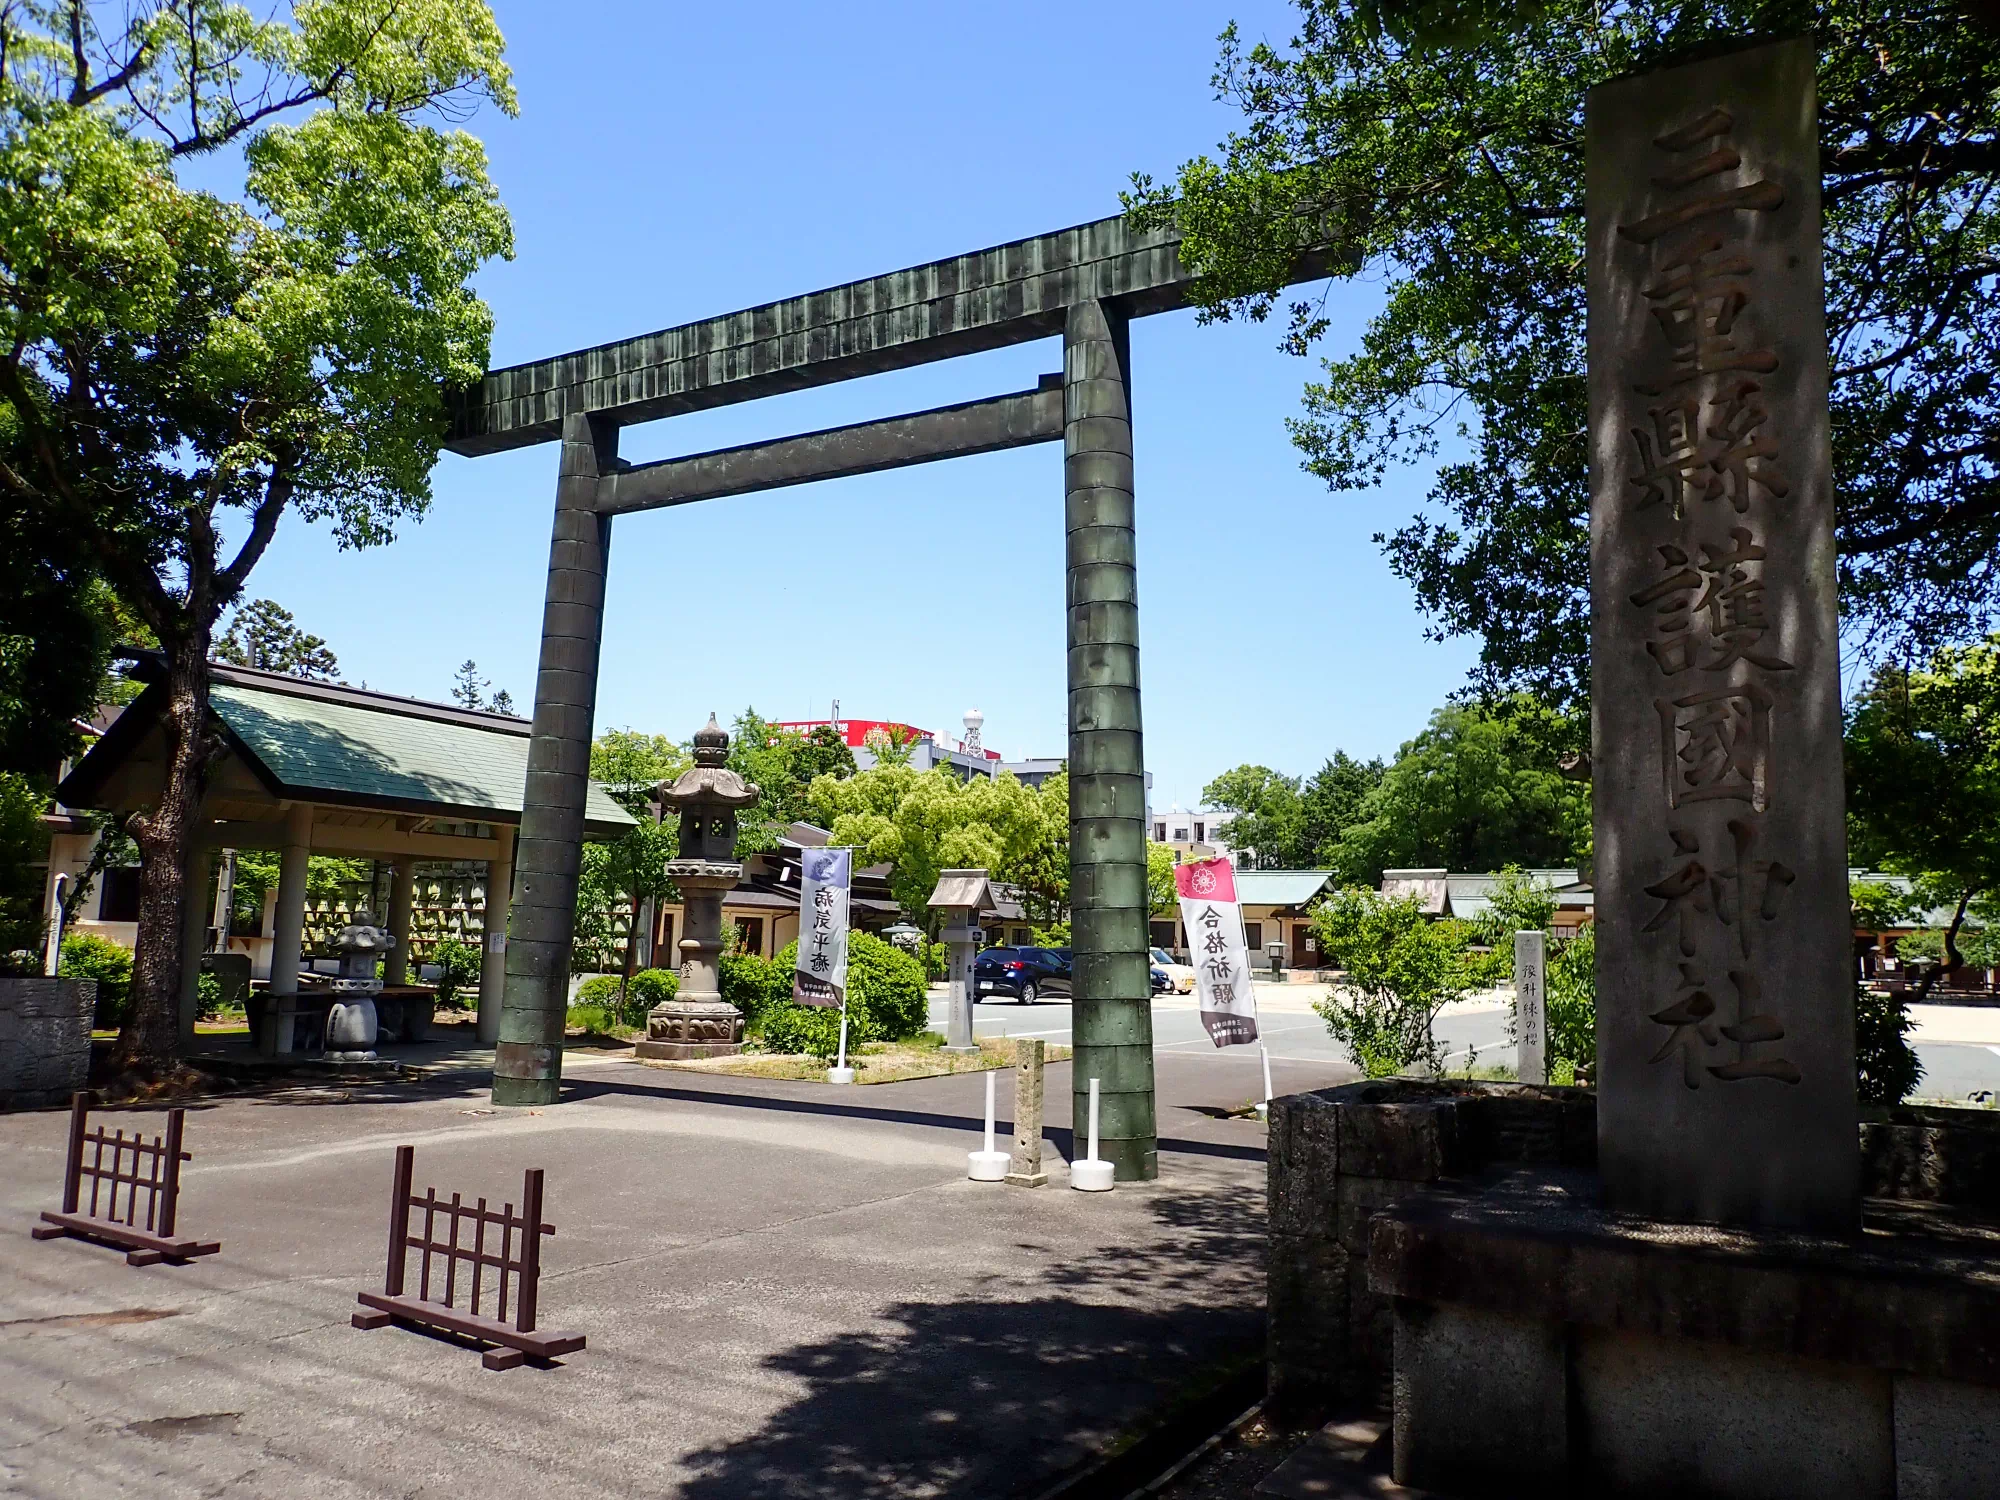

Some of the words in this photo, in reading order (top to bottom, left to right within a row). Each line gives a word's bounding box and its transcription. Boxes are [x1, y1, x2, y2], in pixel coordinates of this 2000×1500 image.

[1616, 108, 1802, 1092] 三重縣護國神社
